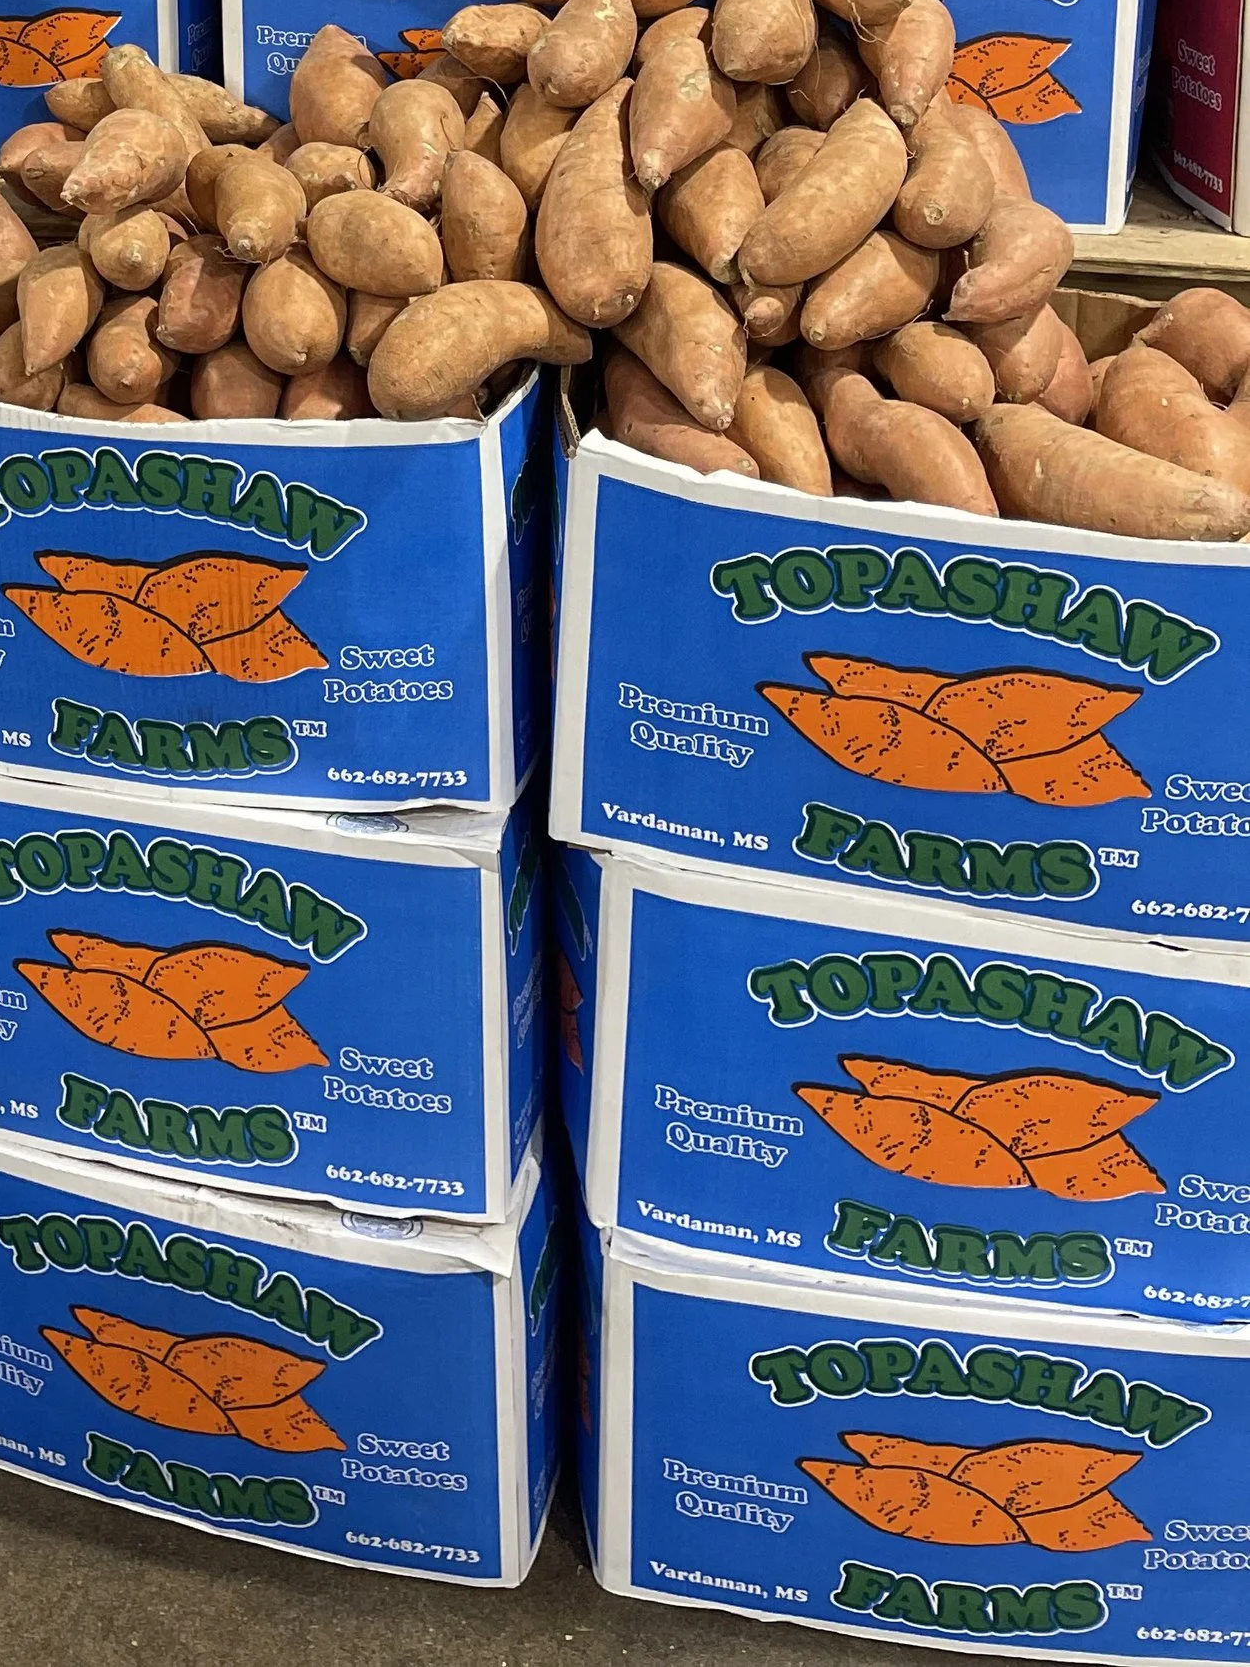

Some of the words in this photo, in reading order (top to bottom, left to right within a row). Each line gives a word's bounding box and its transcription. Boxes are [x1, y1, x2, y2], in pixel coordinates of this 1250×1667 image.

[1177, 39, 1216, 76] Sweet
[1172, 66, 1222, 111] Potatoes
[710, 544, 1220, 684] TOPASHAW
[339, 644, 435, 670] Sweet
[323, 678, 453, 703] Potatoes
[618, 683, 769, 737] Premium
[1, 731, 31, 749] MS
[48, 697, 298, 779] FARMS
[630, 721, 754, 768] Quality
[327, 767, 468, 788] 662-682-7733
[601, 802, 726, 848] Vardaman,
[732, 830, 769, 852] MS
[792, 801, 1099, 900] FARMS
[747, 950, 1235, 1092] TOPASHAW
[338, 1047, 434, 1080] Sweet
[9, 1099, 39, 1120] MS
[323, 1076, 451, 1115] Potatoes
[654, 1084, 804, 1137] Premium
[57, 1072, 298, 1167] FARMS
[666, 1123, 787, 1168] Quality
[326, 1163, 466, 1198] 662-682-7733
[637, 1200, 760, 1244] Vardaman,
[766, 1229, 802, 1249] MS
[1155, 1203, 1250, 1234] Potat
[823, 1199, 1114, 1289] FARMS
[748, 1337, 1212, 1450] TOPASHAW
[37, 1445, 67, 1468] MS
[357, 1433, 450, 1462] Sweet
[82, 1432, 319, 1528] FARMS
[341, 1458, 468, 1493] Potatoes
[662, 1458, 808, 1506] Premium
[676, 1491, 794, 1533] Quality
[345, 1529, 481, 1564] 662-682-7733
[650, 1561, 769, 1599] Vardaman,
[775, 1584, 808, 1604] MS
[830, 1559, 1109, 1639] FARMS
